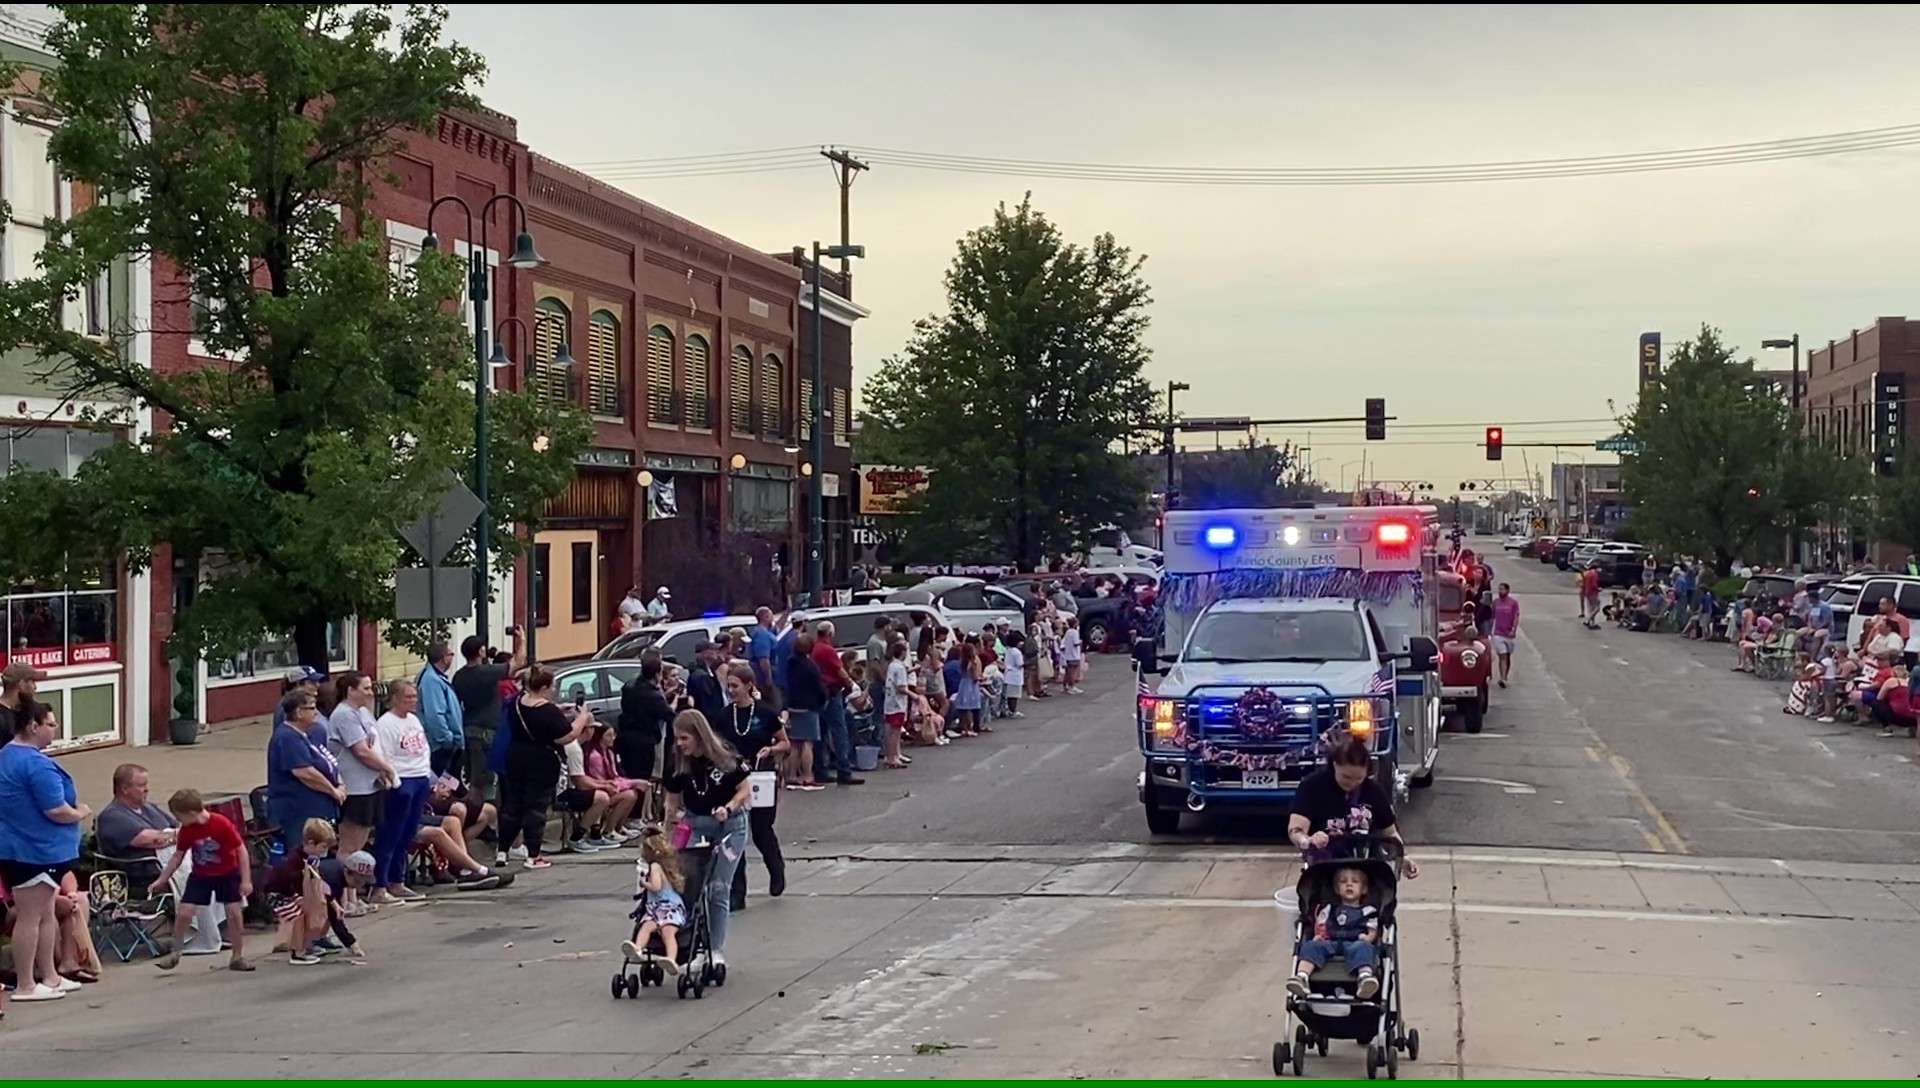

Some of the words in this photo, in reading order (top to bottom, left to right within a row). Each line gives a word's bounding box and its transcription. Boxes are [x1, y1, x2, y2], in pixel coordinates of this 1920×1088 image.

[1267, 554, 1309, 569] County
[1311, 553, 1336, 565] EMS
[11, 653, 33, 665] TAKE
[34, 653, 41, 665] &
[41, 650, 63, 664] BAKE
[73, 646, 110, 661] CATERING
